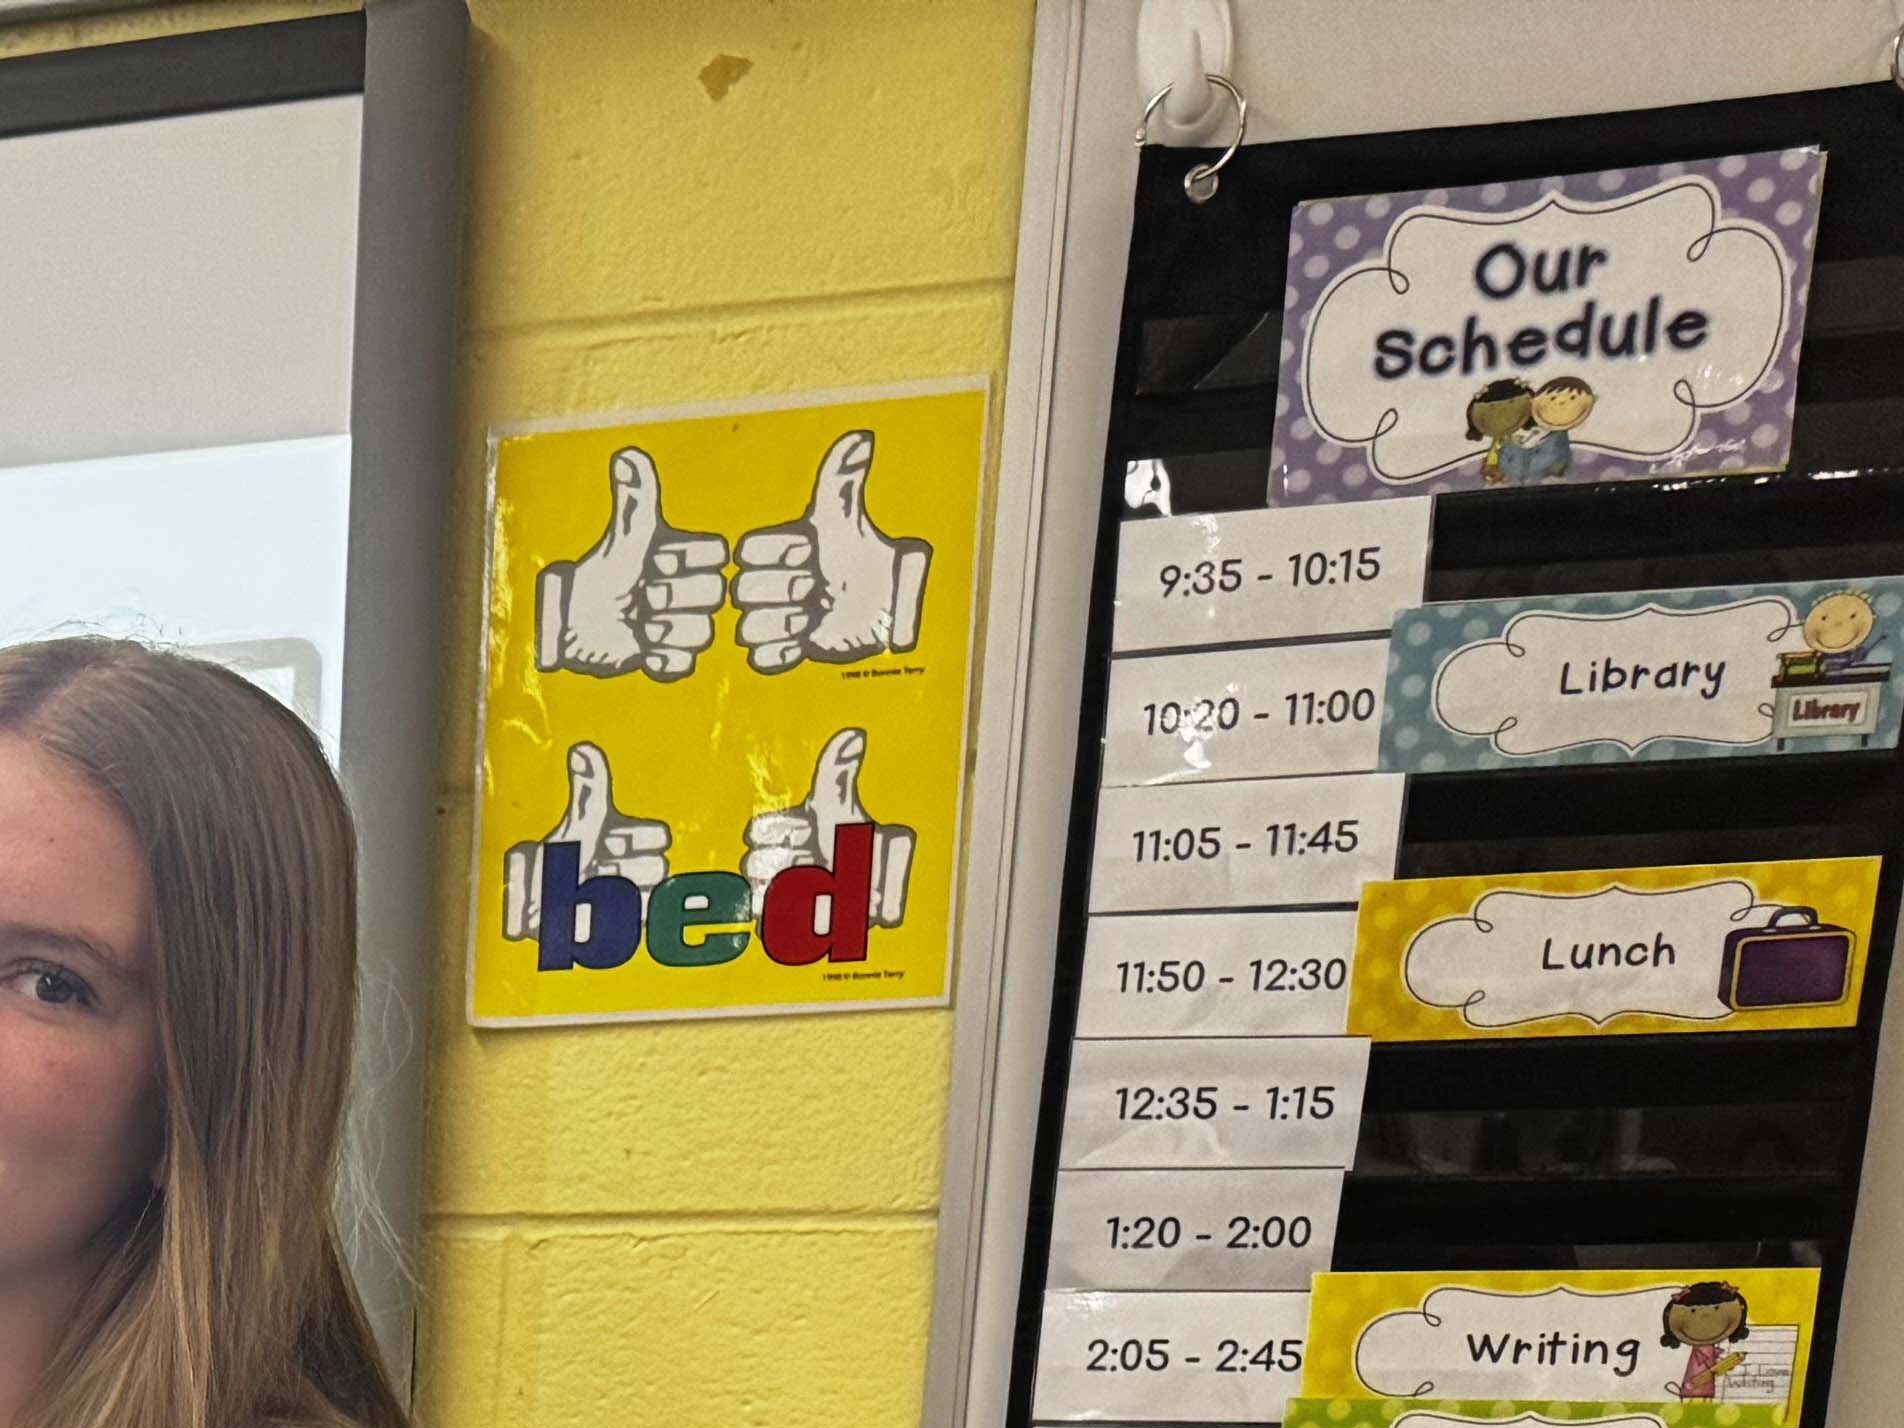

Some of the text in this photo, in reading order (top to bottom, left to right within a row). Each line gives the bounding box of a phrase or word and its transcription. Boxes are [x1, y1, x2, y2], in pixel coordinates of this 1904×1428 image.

[1475, 242, 1611, 300] Our
[1375, 296, 1708, 379] Schedule
[1160, 546, 1381, 598] 9:35 - 10:15
[1560, 657, 1726, 699] Library
[1253, 711, 1269, 719] -
[1285, 687, 1376, 726] 11:00
[1792, 699, 1861, 722] Library
[1132, 826, 1222, 863] 11:05
[1266, 819, 1360, 857] 11:45
[538, 822, 875, 971] bed
[1542, 932, 1676, 971] Lunch
[1116, 959, 1206, 994] 11:50
[1248, 957, 1347, 993] 12:30
[1115, 1086, 1219, 1121] 12:35
[1266, 1085, 1336, 1121] 1:15
[1106, 1216, 1182, 1250] 1:20
[1226, 1215, 1312, 1249] 2:00
[1086, 1338, 1170, 1372] 2:05
[1215, 1339, 1304, 1373] 2:45
[1467, 1332, 1641, 1378] Writing
